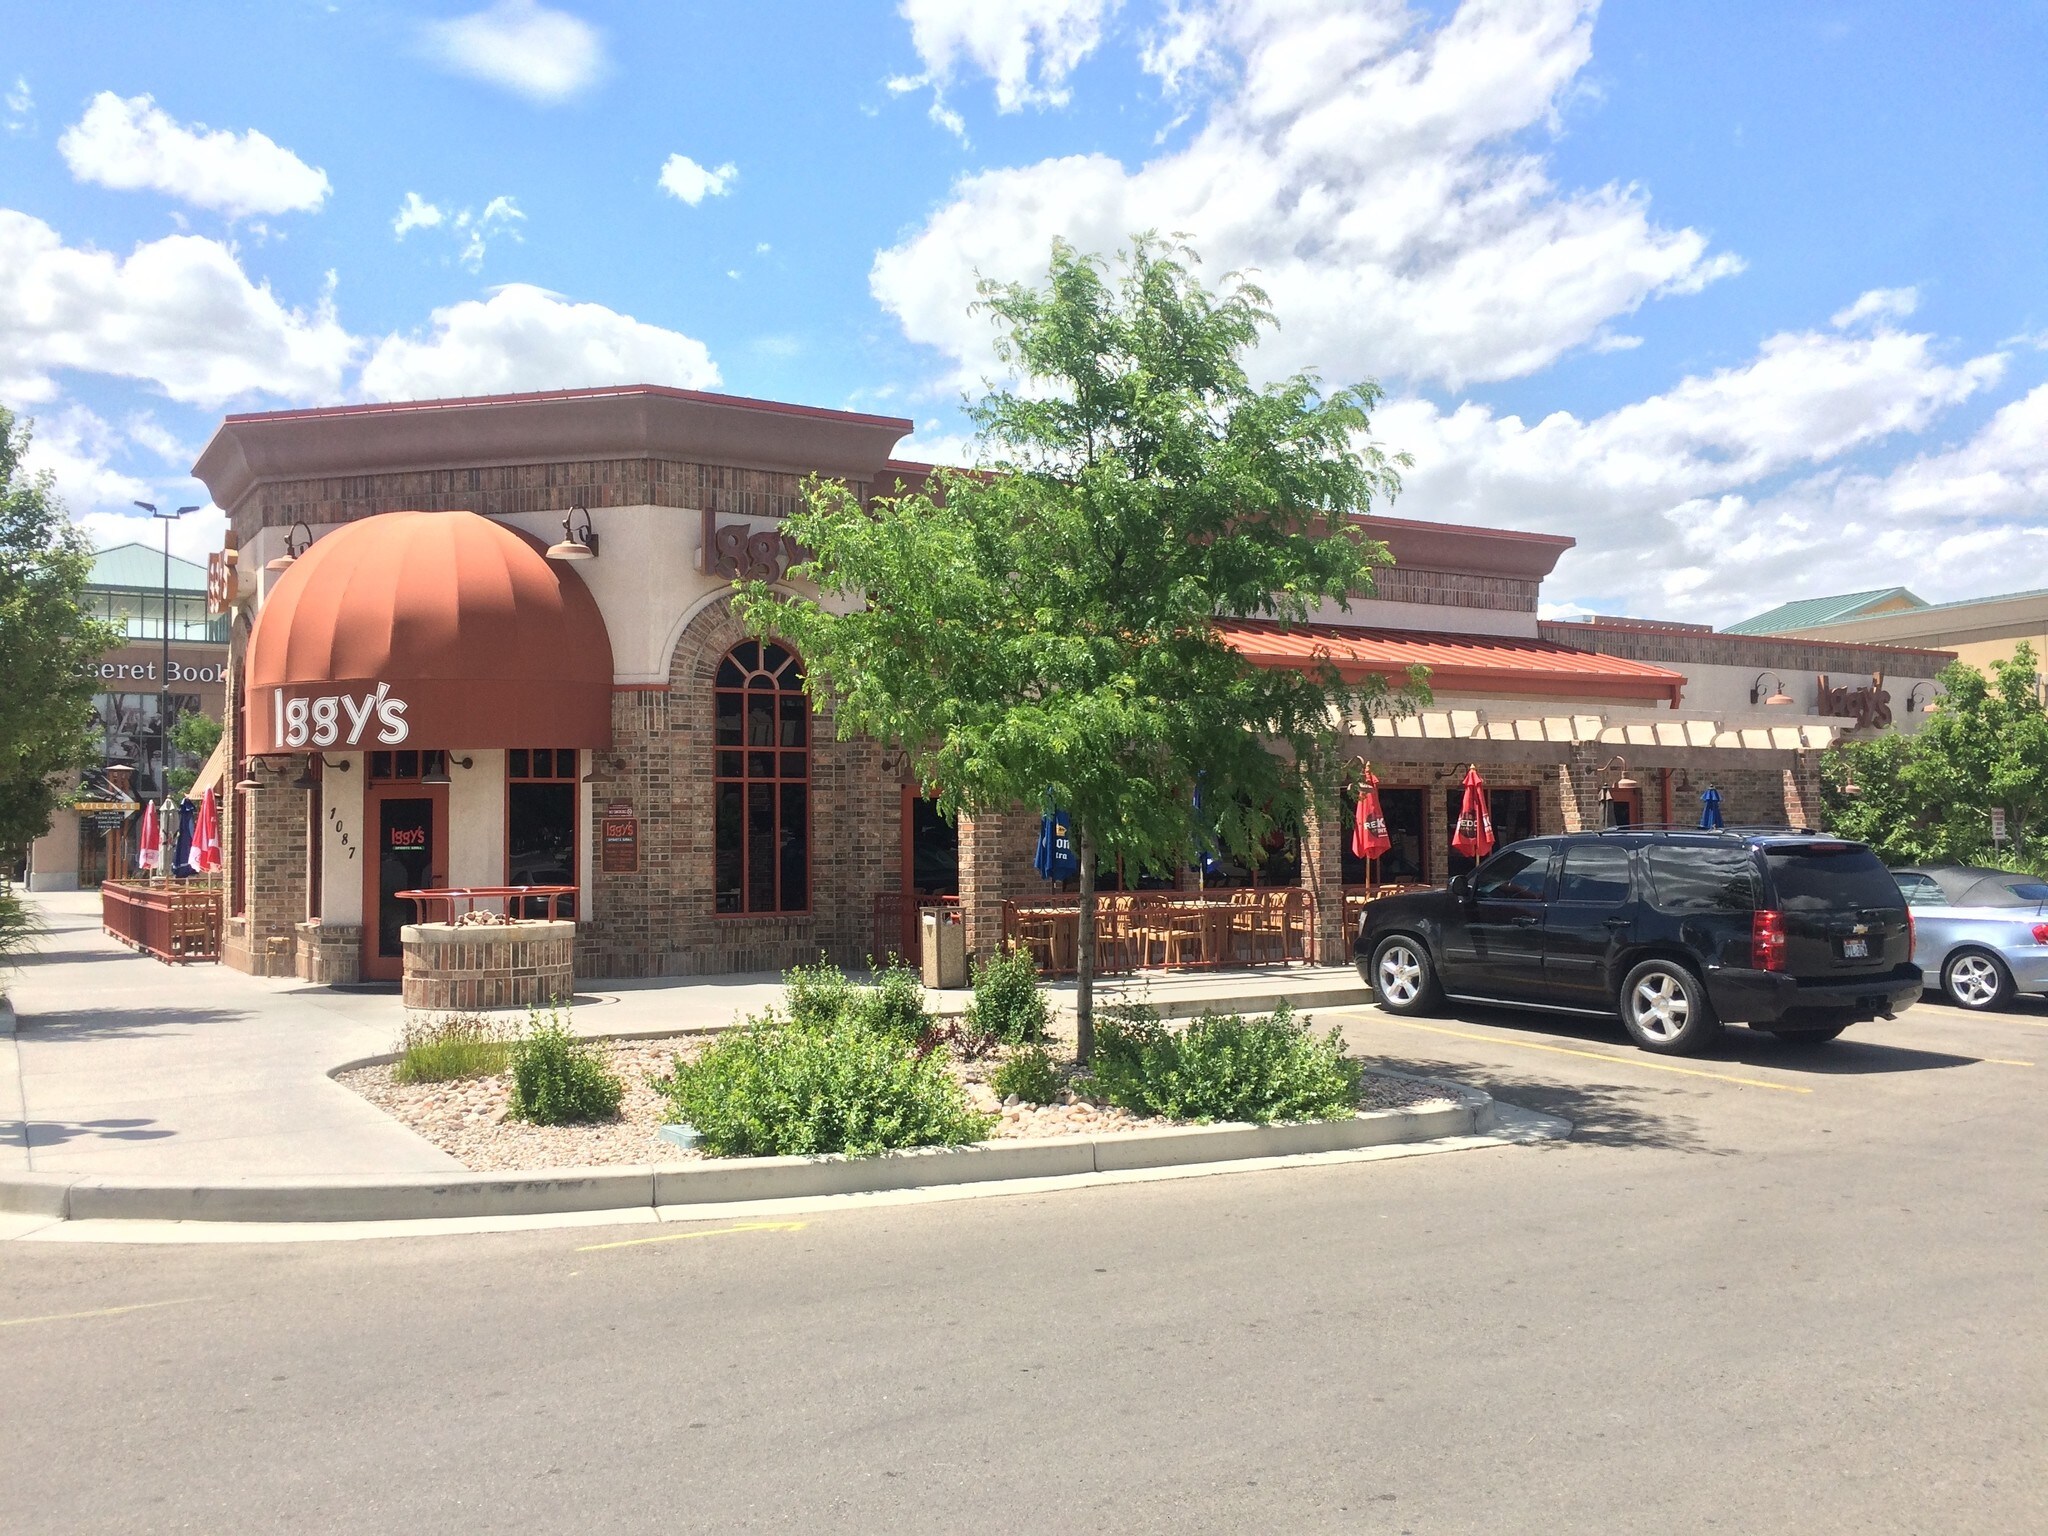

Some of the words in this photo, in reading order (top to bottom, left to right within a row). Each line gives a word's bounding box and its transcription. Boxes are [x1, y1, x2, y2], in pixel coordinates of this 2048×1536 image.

[274, 681, 409, 748] Iggy's
[80, 802, 136, 810] VILLAGE
[329, 807, 356, 860] 1087
[391, 825, 425, 845] Iggy's
[606, 821, 634, 837] Iggy's
